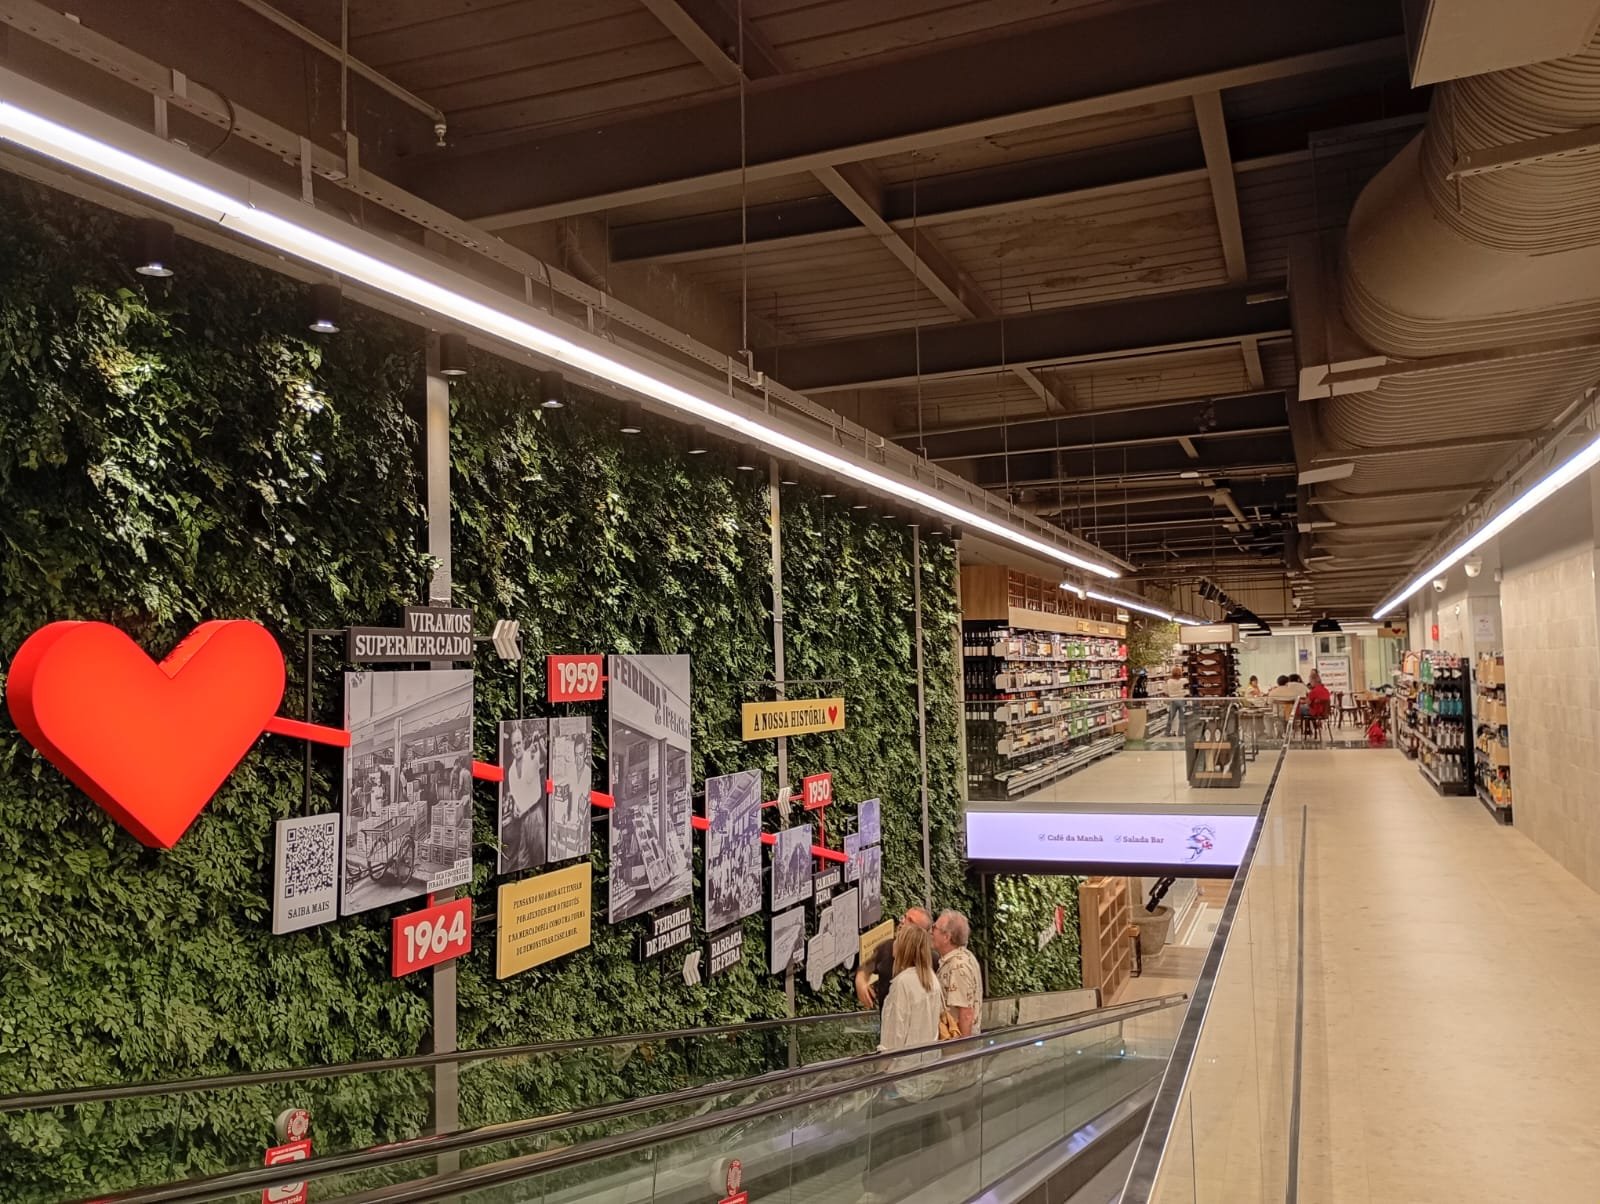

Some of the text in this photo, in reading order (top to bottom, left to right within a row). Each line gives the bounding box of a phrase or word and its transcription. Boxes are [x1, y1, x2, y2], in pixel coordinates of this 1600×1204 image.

[409, 612, 471, 633] VIRAMOS
[355, 635, 471, 656] SUPERMERCADO
[557, 662, 599, 694] 1959
[754, 706, 826, 732] A NOSSA HISTÓRIA
[808, 778, 830, 804] 1950
[1122, 835, 1149, 843] Salada
[288, 900, 330, 919] SAIBA MAIS
[654, 907, 691, 936] FEIRINHA
[404, 910, 466, 963] 1964
[646, 924, 691, 957] DE IPANEMA
[711, 930, 742, 958] BARRACA
[711, 946, 740, 974] DE FEIRA
